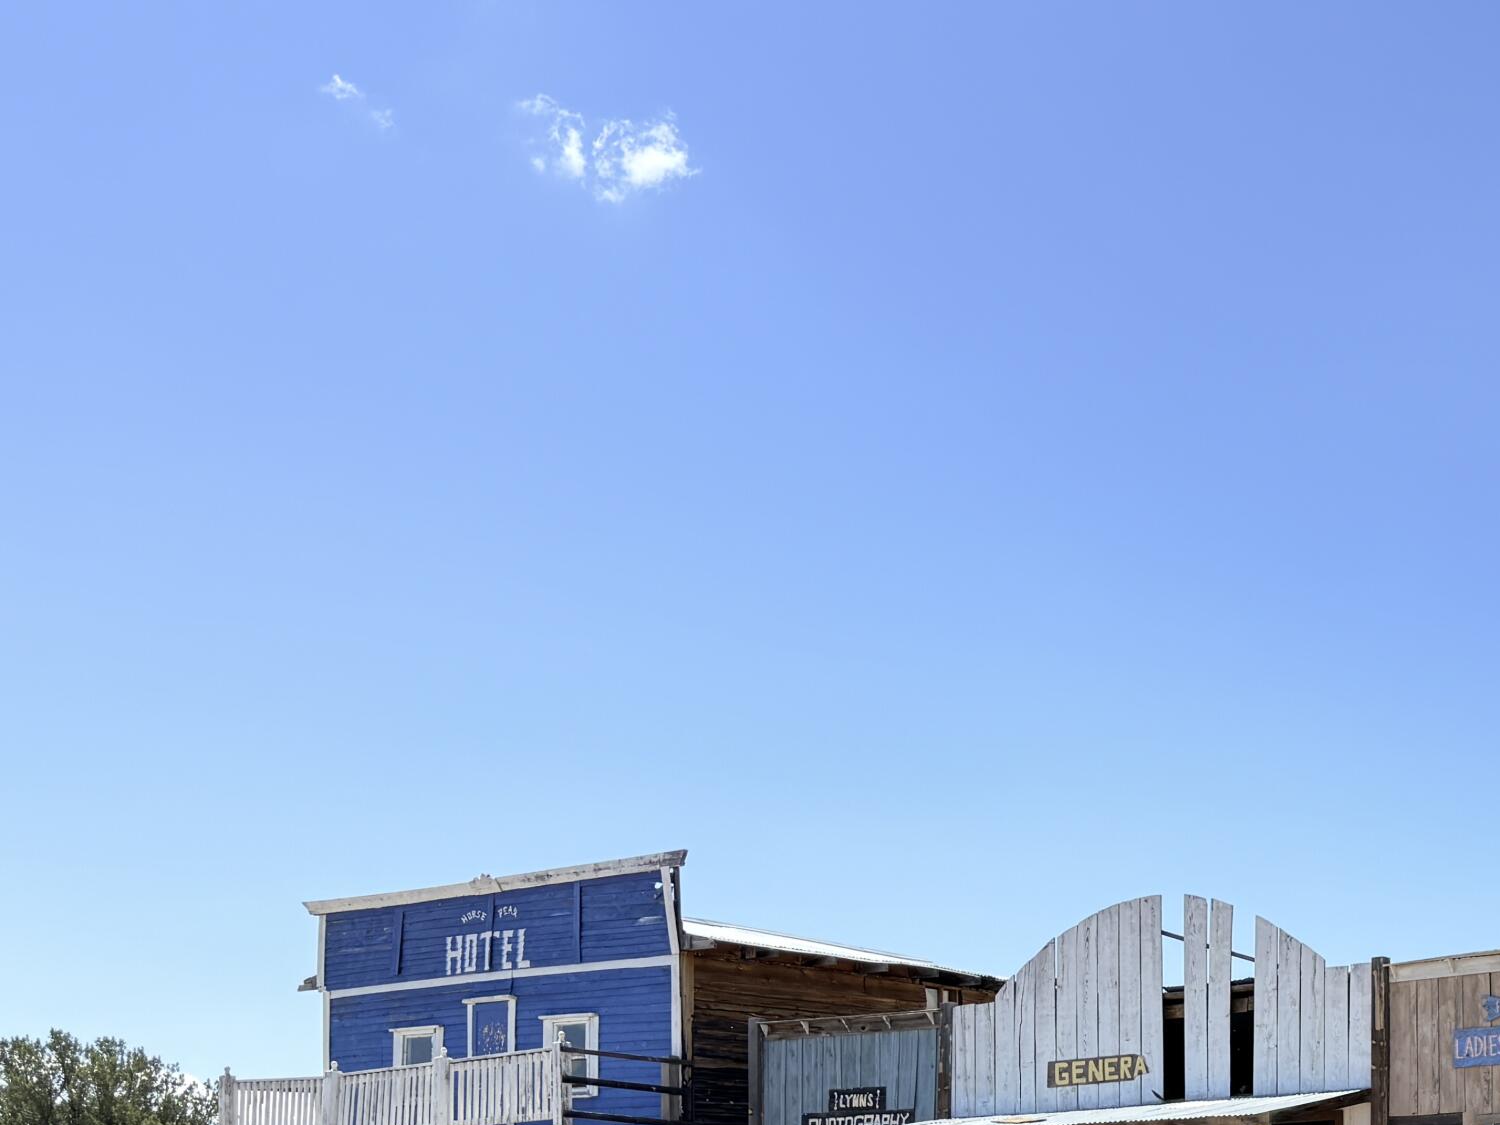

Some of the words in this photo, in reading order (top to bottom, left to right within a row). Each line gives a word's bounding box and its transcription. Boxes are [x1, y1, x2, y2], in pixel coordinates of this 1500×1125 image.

[460, 909, 487, 924] HORSE
[446, 928, 531, 976] HOTEL
[1054, 1055, 1147, 1086] GENERA
[839, 1093, 875, 1109] LYNN'S
